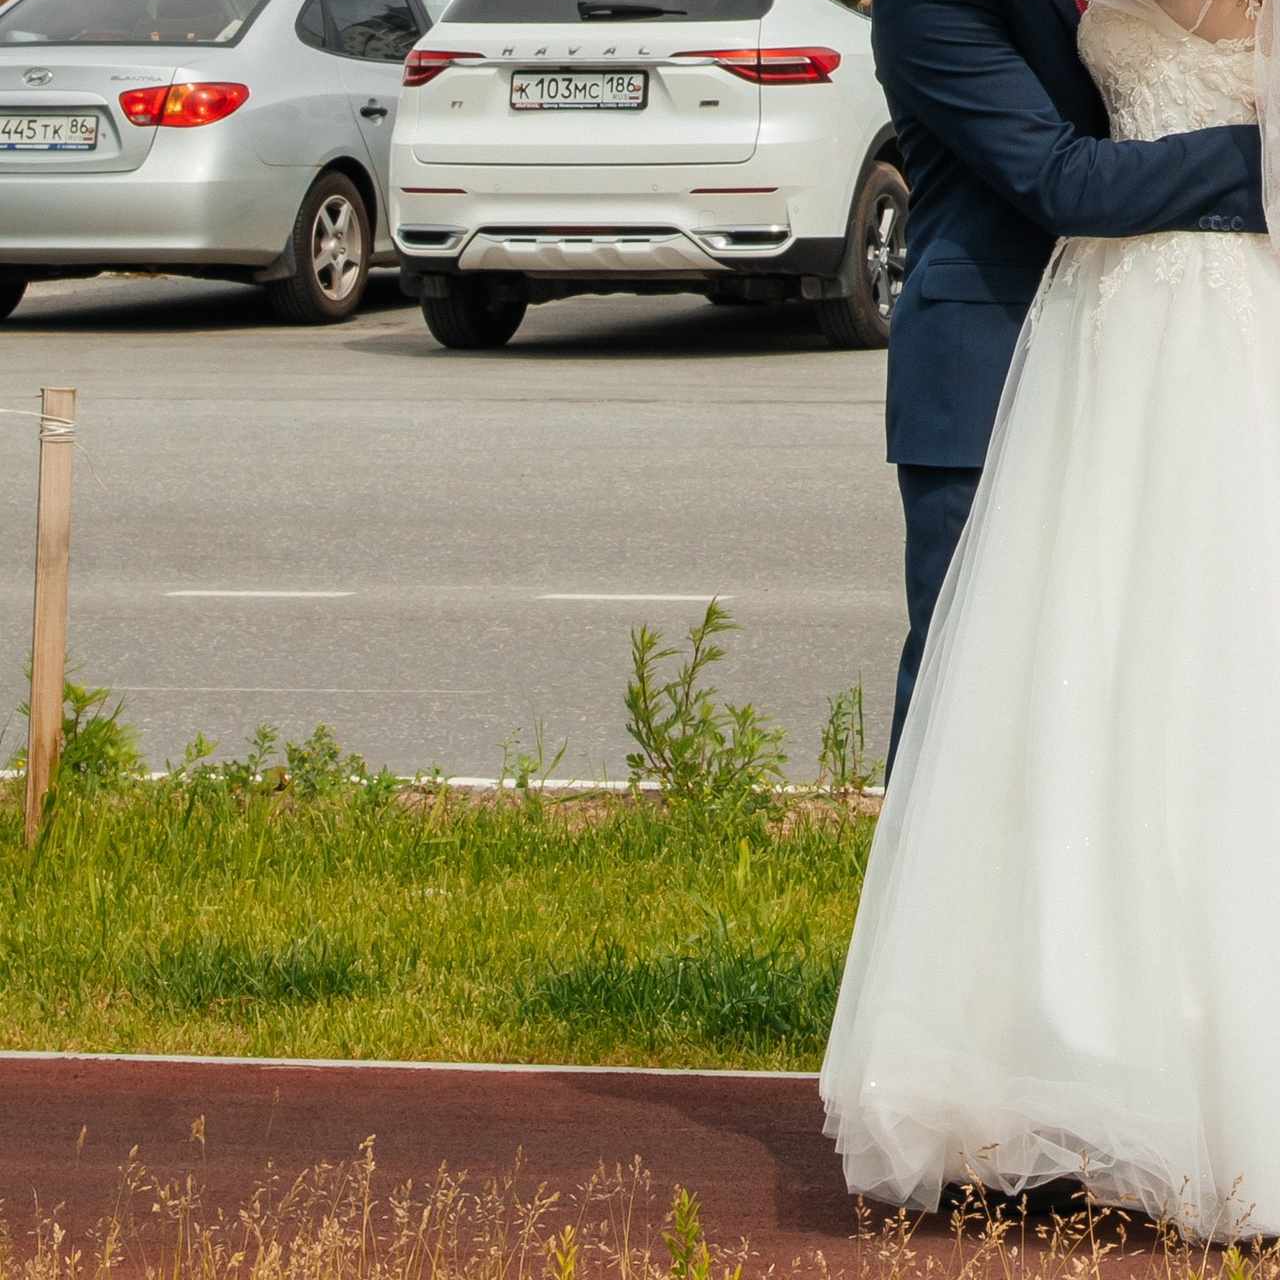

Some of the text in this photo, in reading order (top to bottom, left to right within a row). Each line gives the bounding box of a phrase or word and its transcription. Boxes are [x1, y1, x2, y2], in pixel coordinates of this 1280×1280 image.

[502, 45, 651, 56] HAVAL
[605, 76, 636, 94] 186
[70, 118, 88, 134] 86
